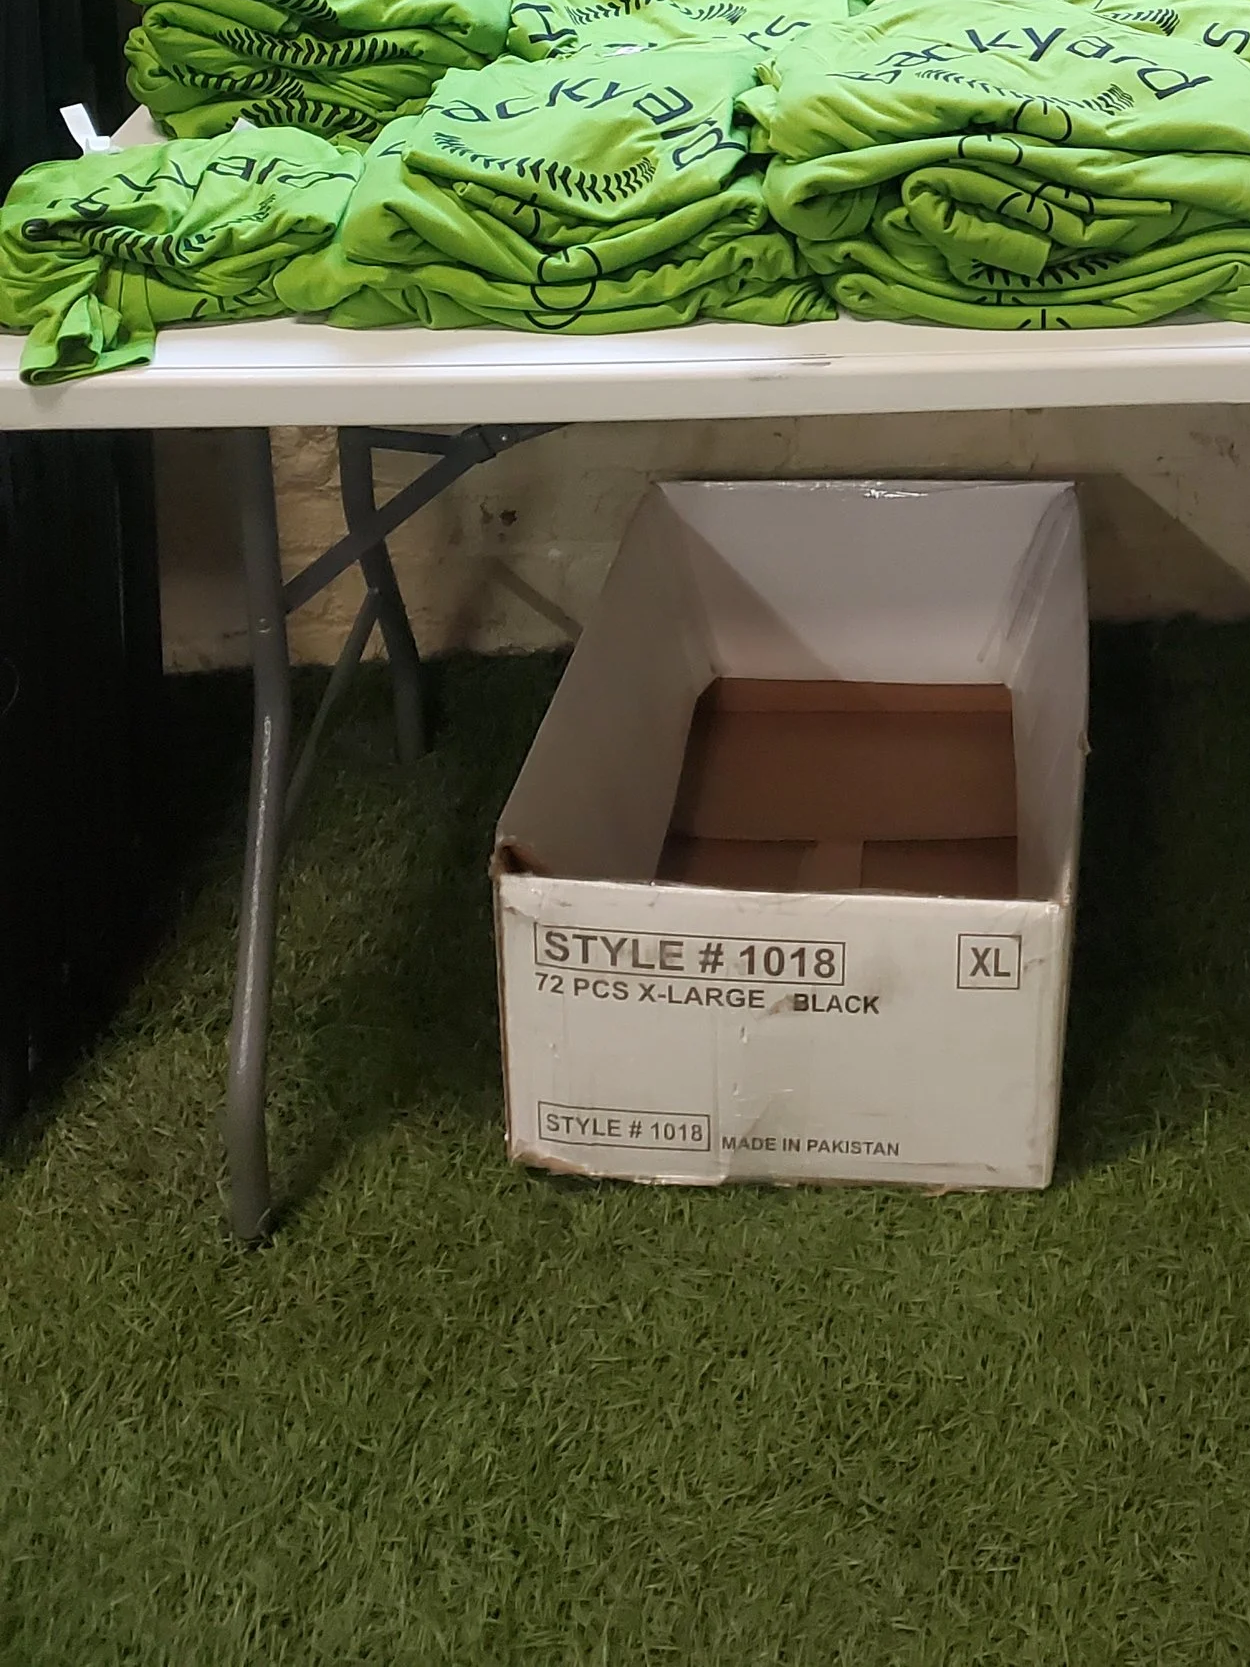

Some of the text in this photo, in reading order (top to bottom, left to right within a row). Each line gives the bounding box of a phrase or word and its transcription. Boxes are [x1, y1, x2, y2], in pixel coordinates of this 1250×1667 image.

[422, 78, 746, 171] ackyard
[543, 931, 837, 978] STYLE # 1018
[970, 948, 1012, 977] XL
[535, 972, 880, 1015] 72 PCS X-LARGE BLACK
[546, 1113, 704, 1142] STYLE # 1018
[722, 1136, 900, 1157] MADE IN PAKISTAN
